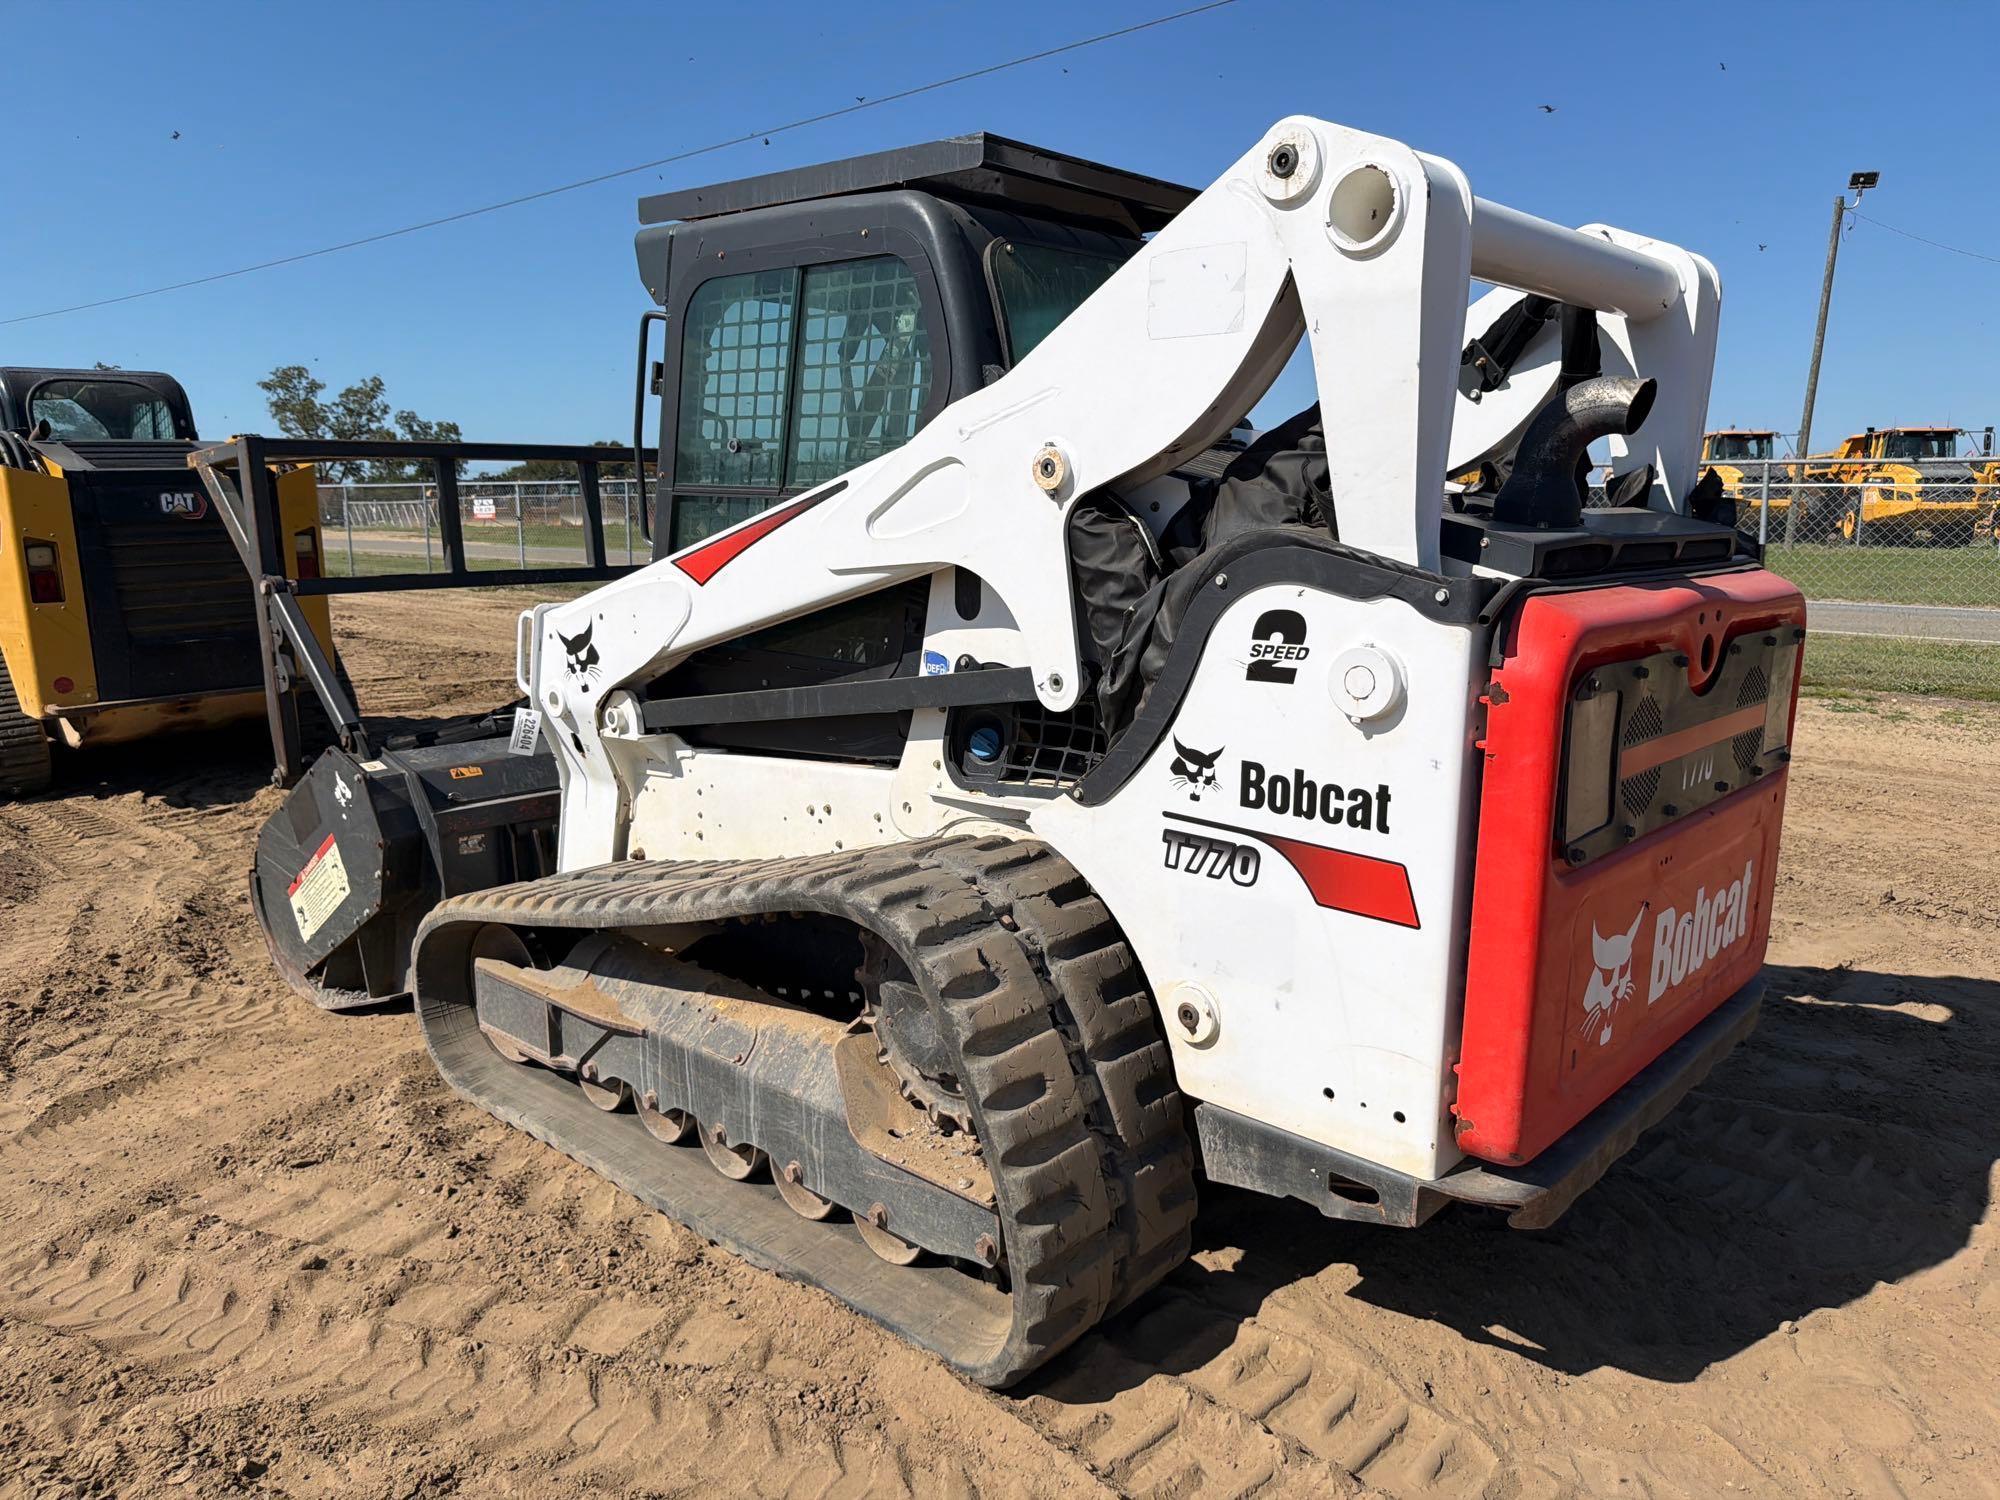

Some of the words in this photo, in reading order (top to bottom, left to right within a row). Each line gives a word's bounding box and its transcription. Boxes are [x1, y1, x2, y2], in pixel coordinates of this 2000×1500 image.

[161, 493, 194, 512] CAT
[926, 663, 941, 673] DEF
[1246, 609, 1307, 684] 2
[1249, 644, 1310, 660] SPEED
[519, 718, 537, 750] 226404
[1240, 760, 1391, 835] Bobcat
[1162, 829, 1261, 888] T770
[1648, 860, 1753, 1005] Bobcat
